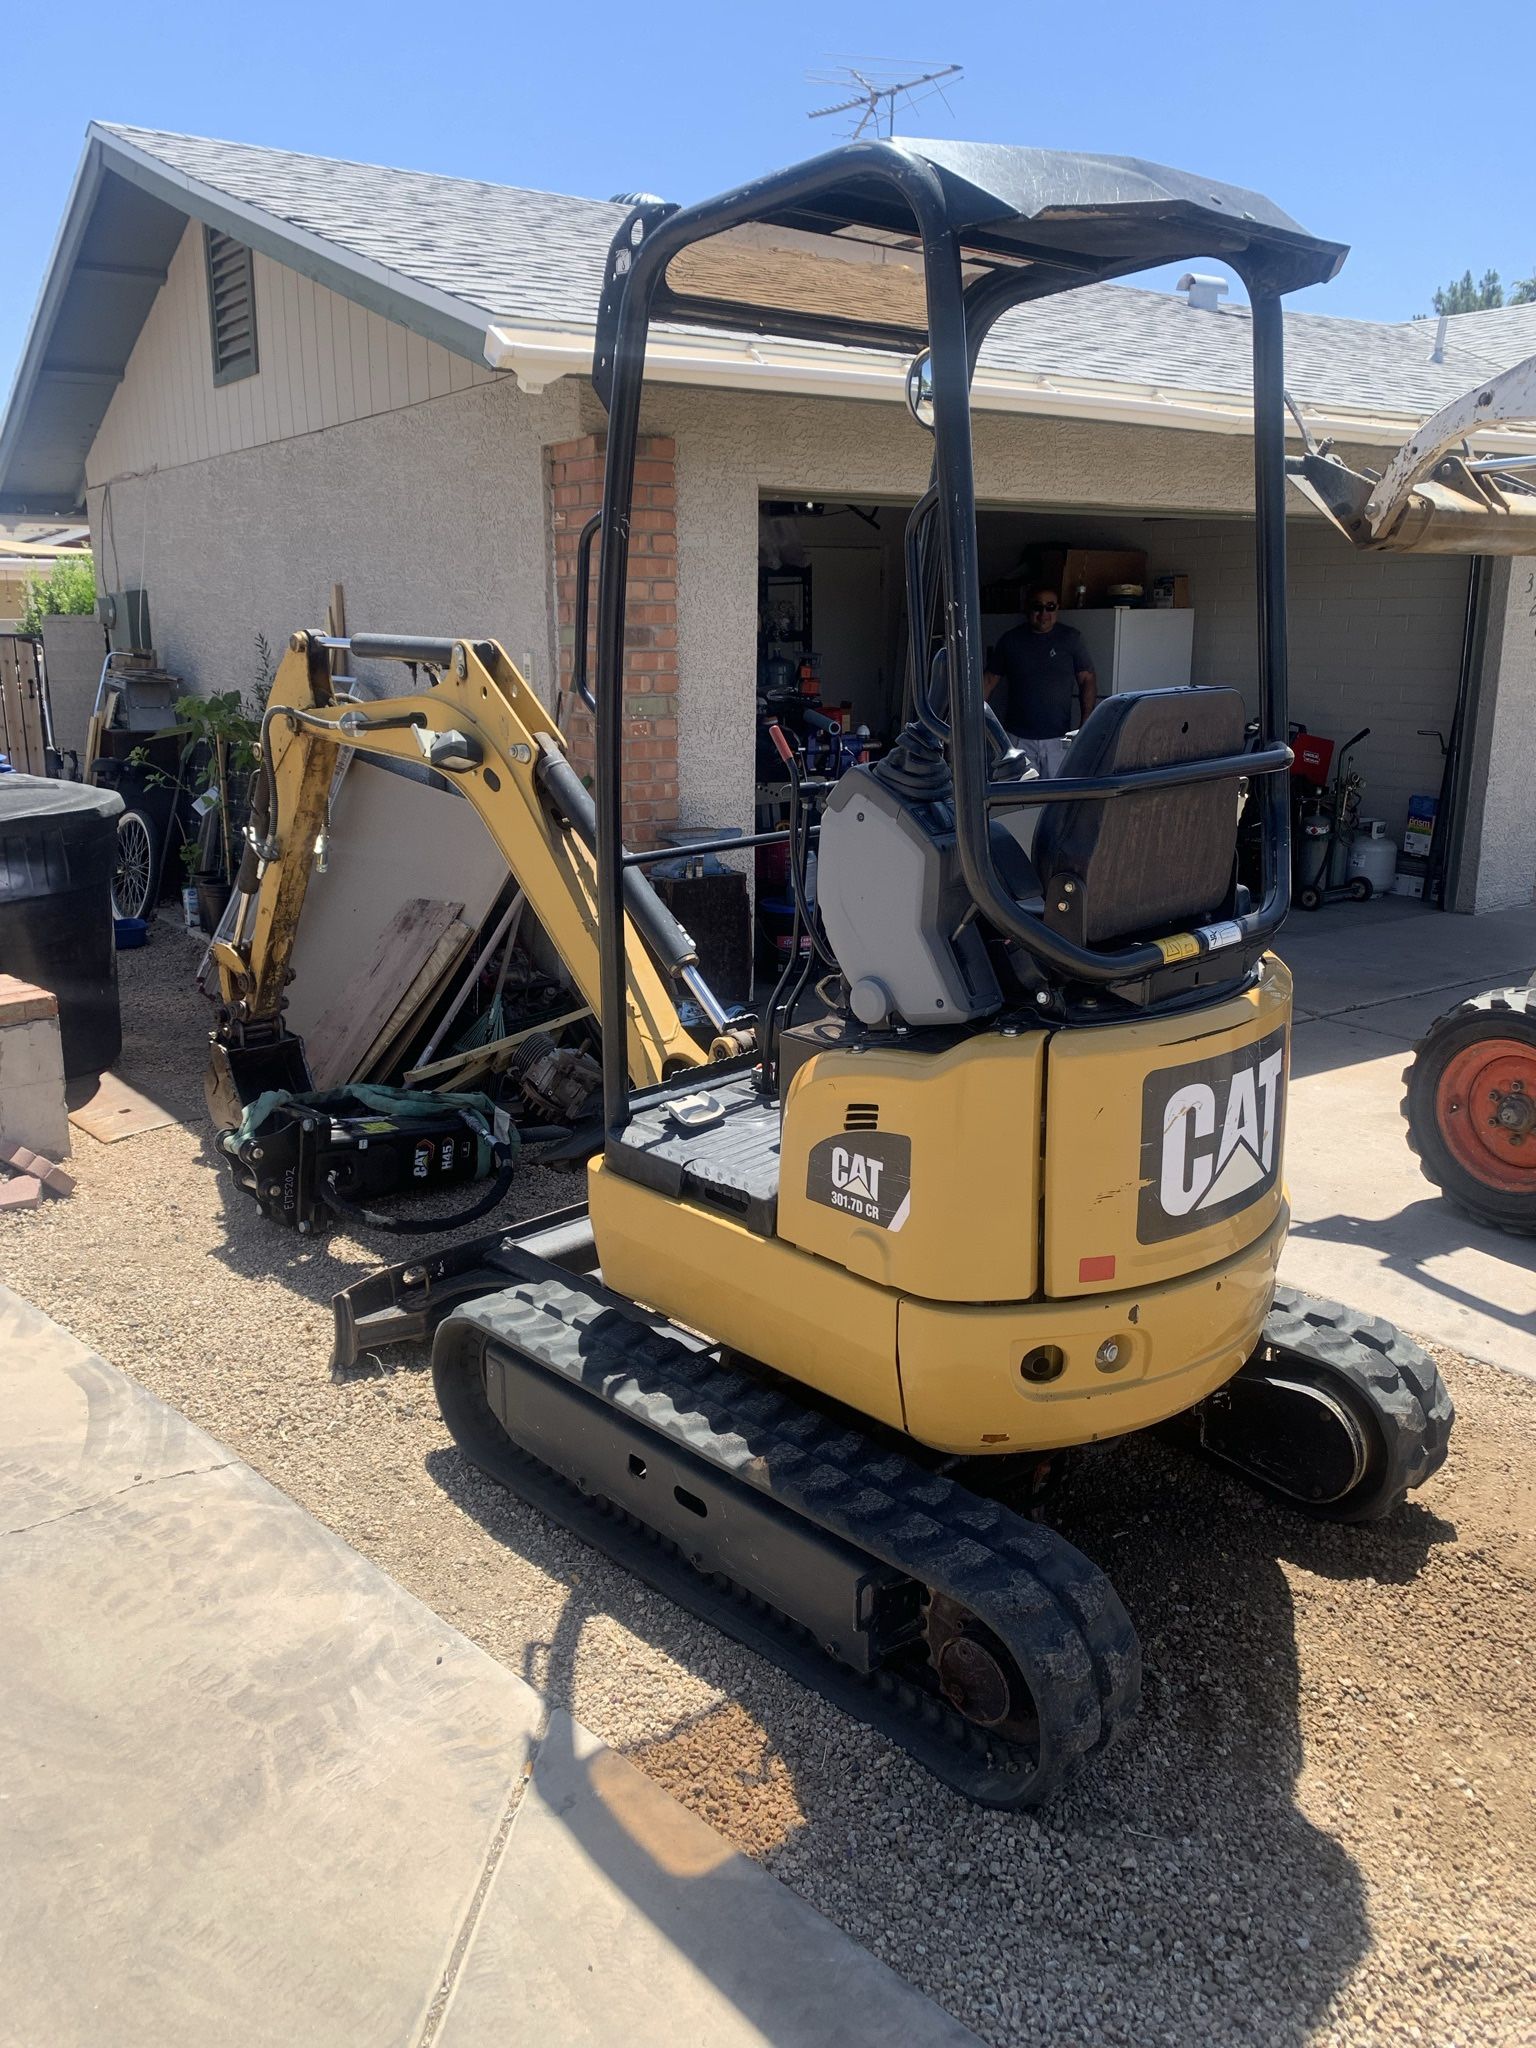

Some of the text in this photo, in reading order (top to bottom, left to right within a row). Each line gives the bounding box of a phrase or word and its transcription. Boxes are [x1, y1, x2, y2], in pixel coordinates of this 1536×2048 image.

[1160, 1048, 1283, 1216] CAT
[413, 1149, 428, 1178] CAT
[441, 1144, 453, 1170] H45
[831, 1147, 884, 1202] CAT
[831, 1191, 879, 1220] 301.7D CR
